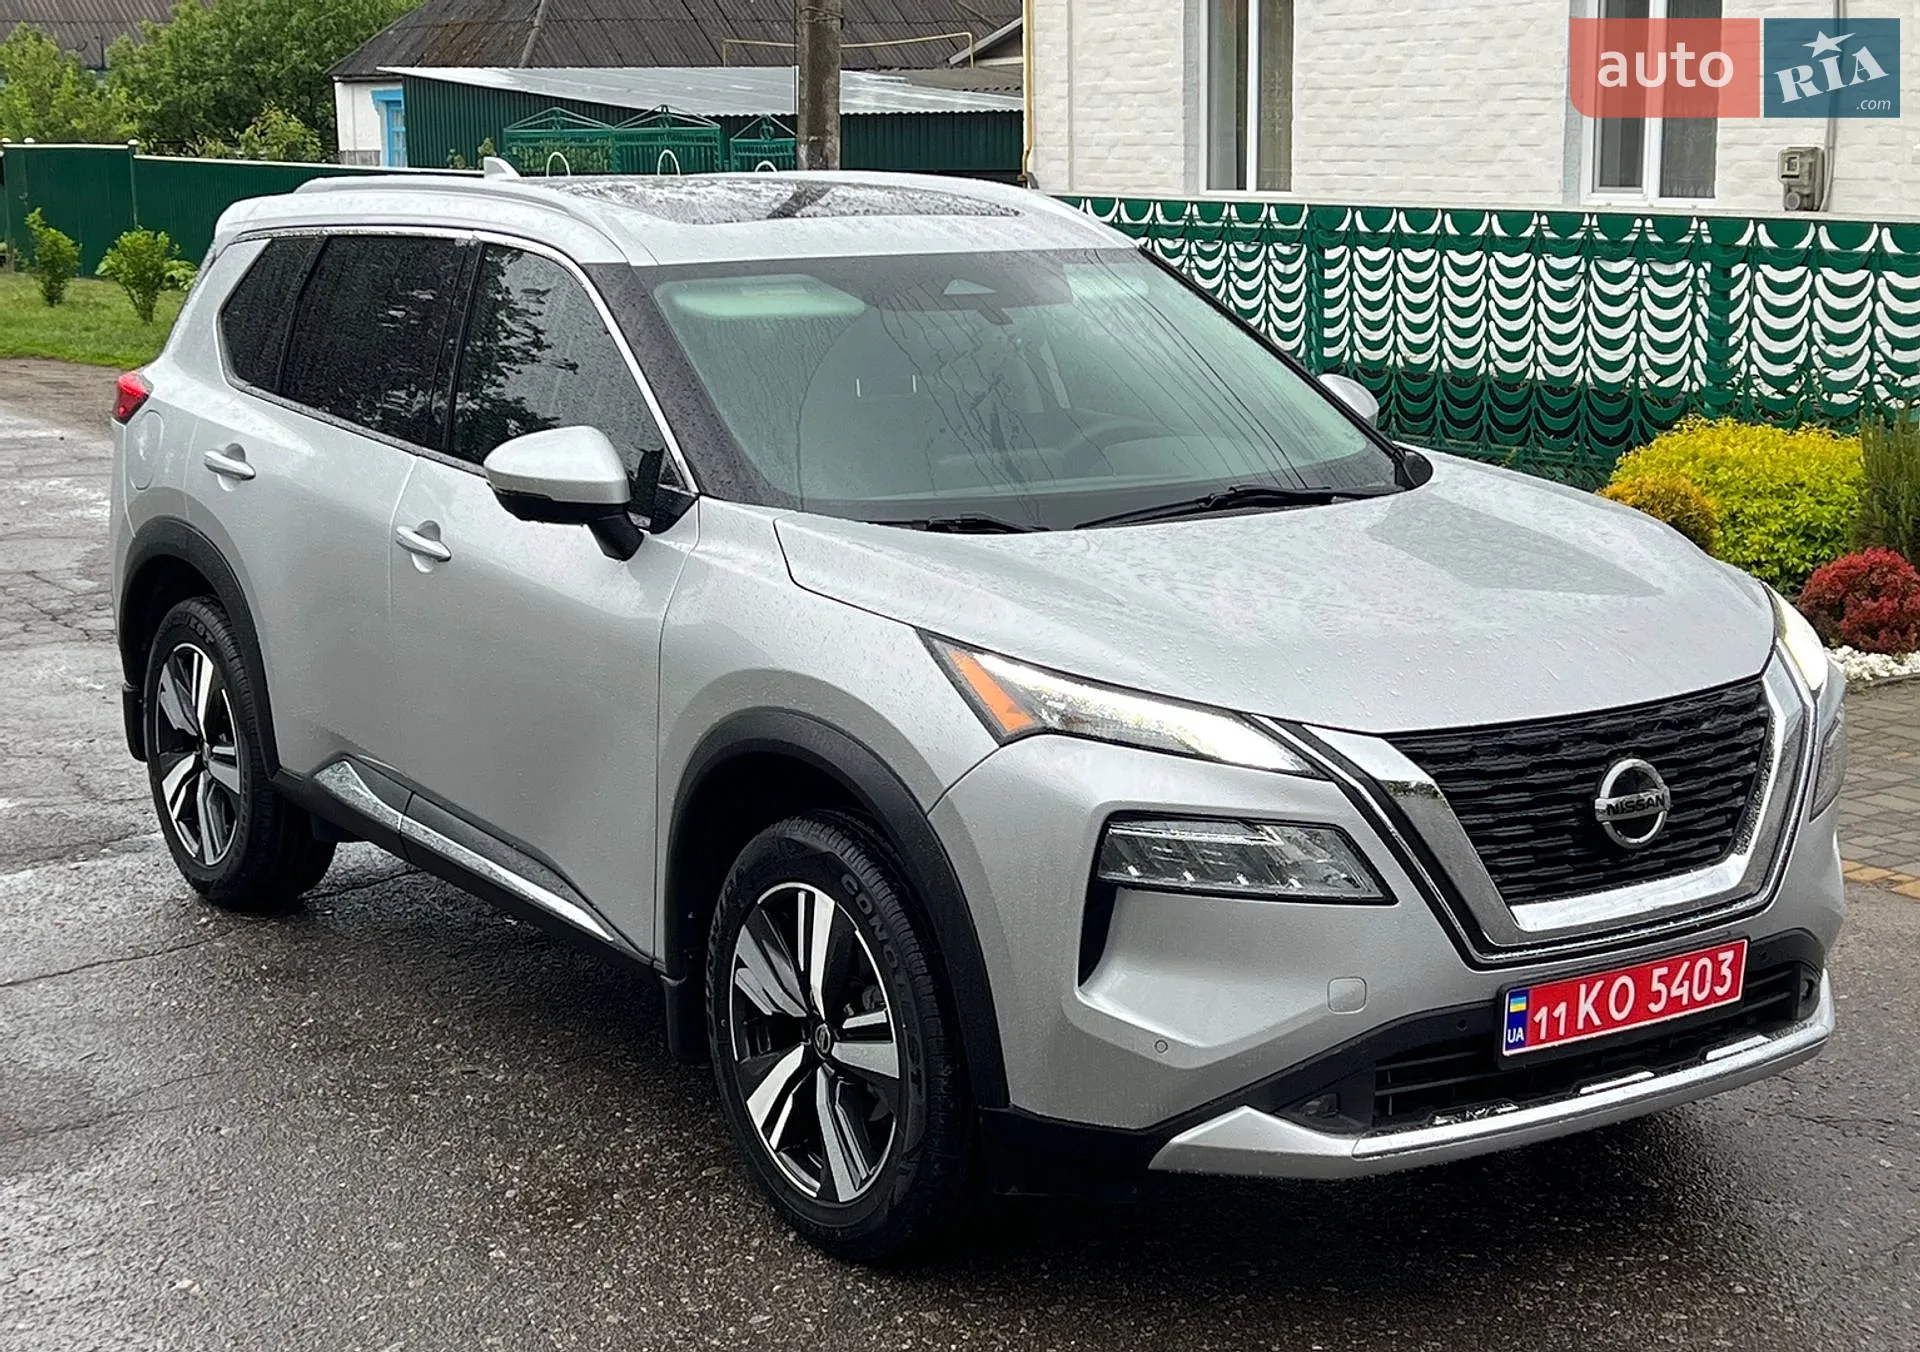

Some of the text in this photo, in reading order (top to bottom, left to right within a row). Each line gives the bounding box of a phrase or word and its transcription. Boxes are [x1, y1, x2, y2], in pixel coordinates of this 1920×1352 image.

[1606, 793, 1665, 817] NISSAN
[1648, 950, 1735, 1013] 5403
[1507, 1026, 1525, 1044] UA
